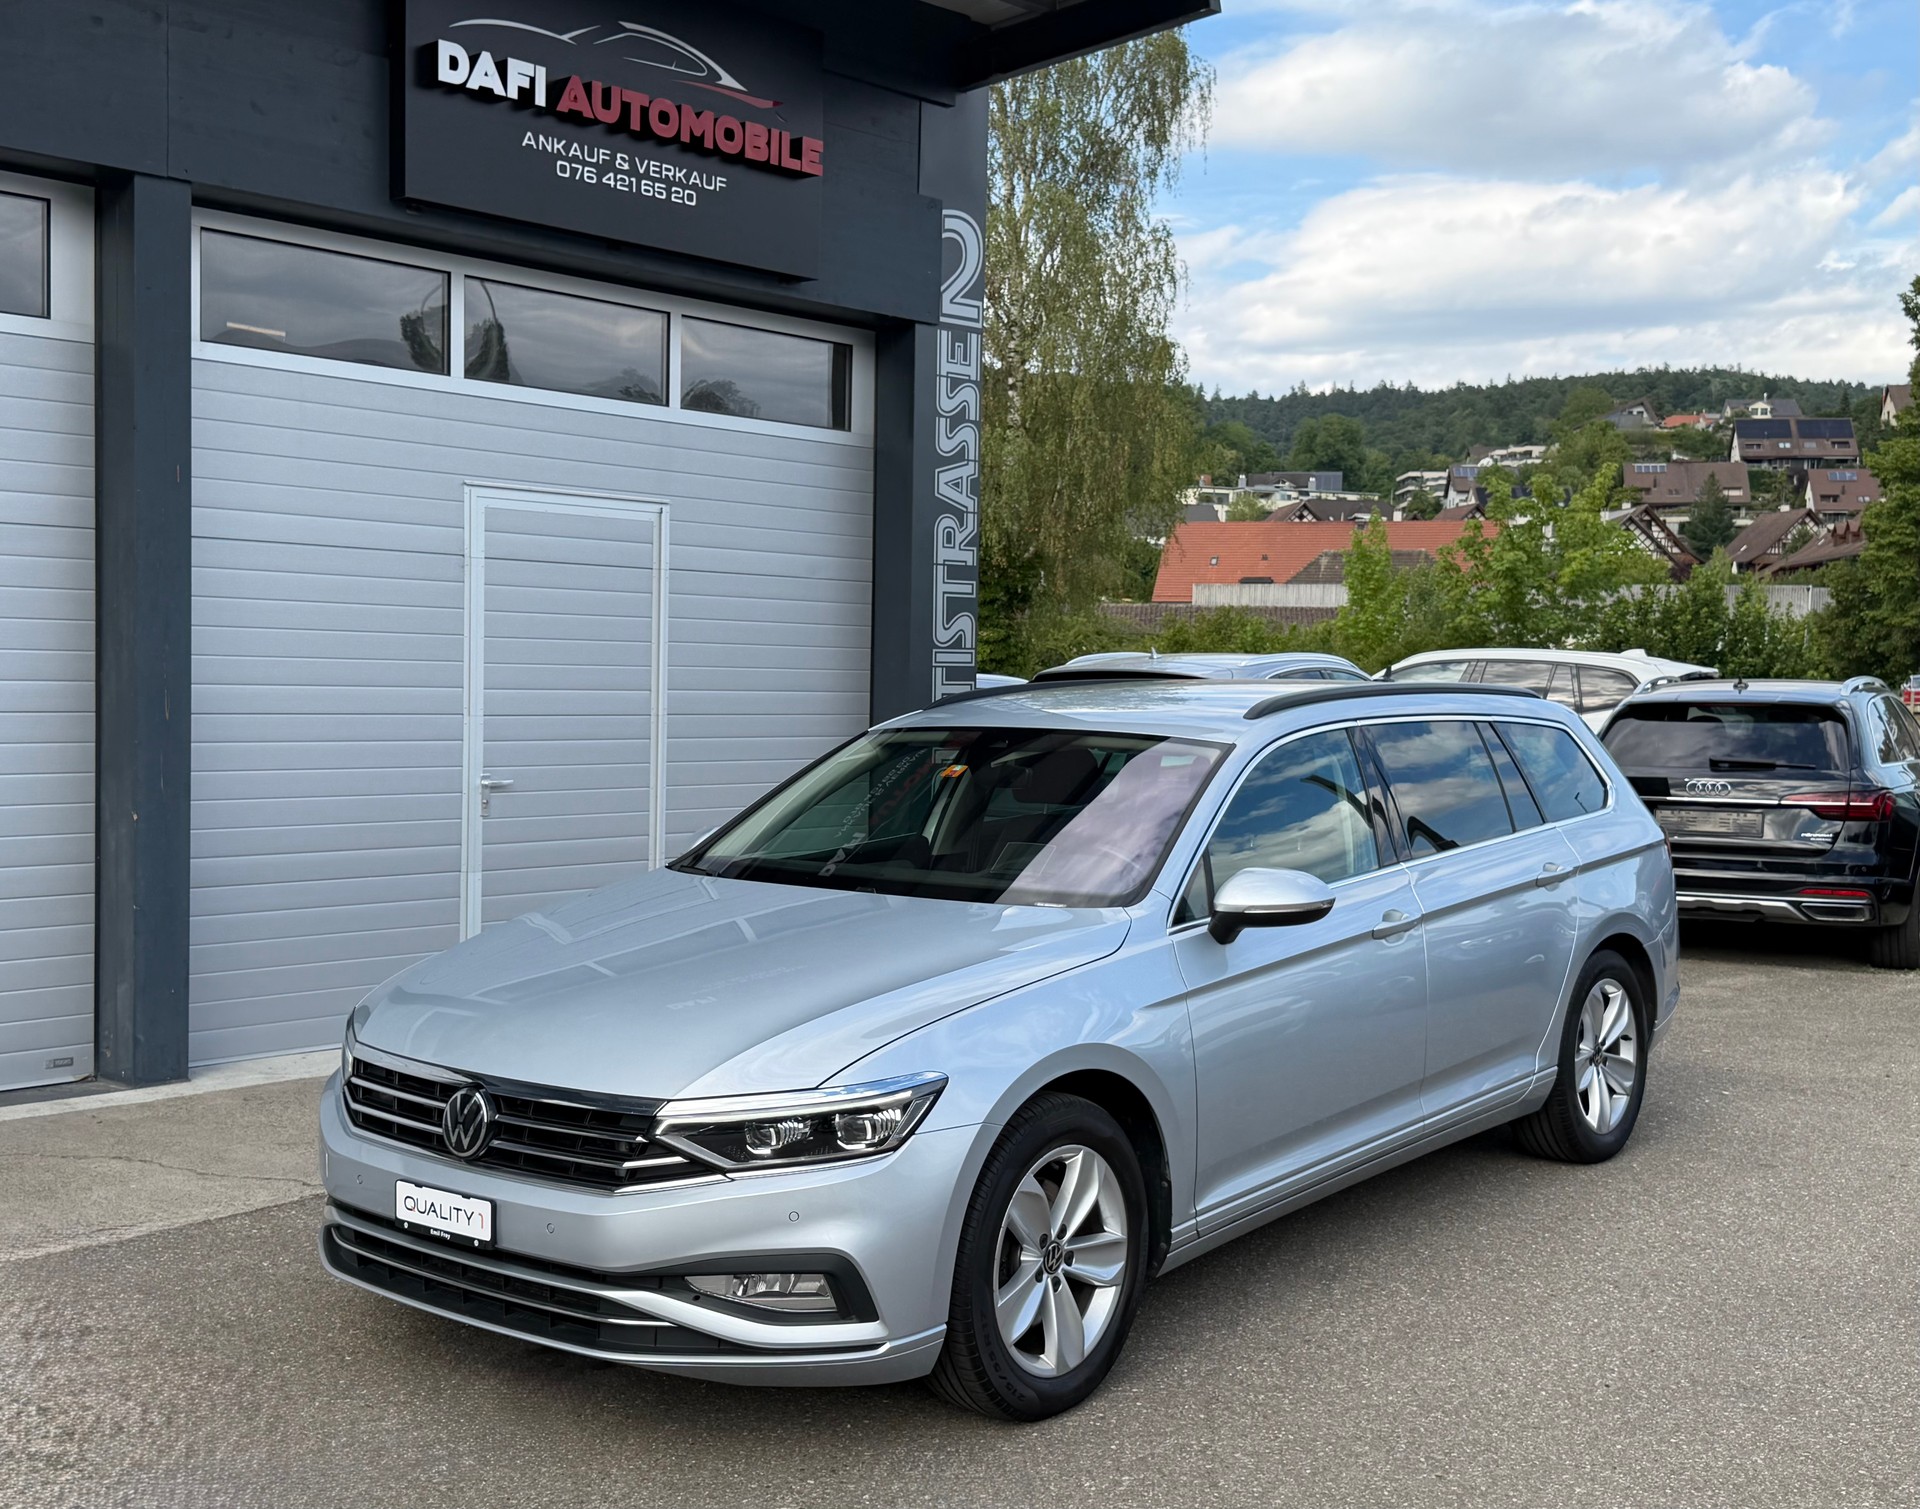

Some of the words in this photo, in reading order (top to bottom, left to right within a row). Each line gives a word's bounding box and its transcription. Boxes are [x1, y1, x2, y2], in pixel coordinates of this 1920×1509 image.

[437, 38, 547, 107] DAFI
[556, 75, 824, 177] AUTOMOBILE
[521, 131, 611, 165] ANKAUF
[615, 153, 630, 171] &
[634, 156, 728, 192] VERKAUF
[556, 160, 597, 184] 076
[602, 172, 637, 193] 421
[640, 179, 667, 200] 65
[671, 187, 697, 207] 20
[939, 209, 984, 329] 2
[403, 1195, 475, 1226] QUALITY
